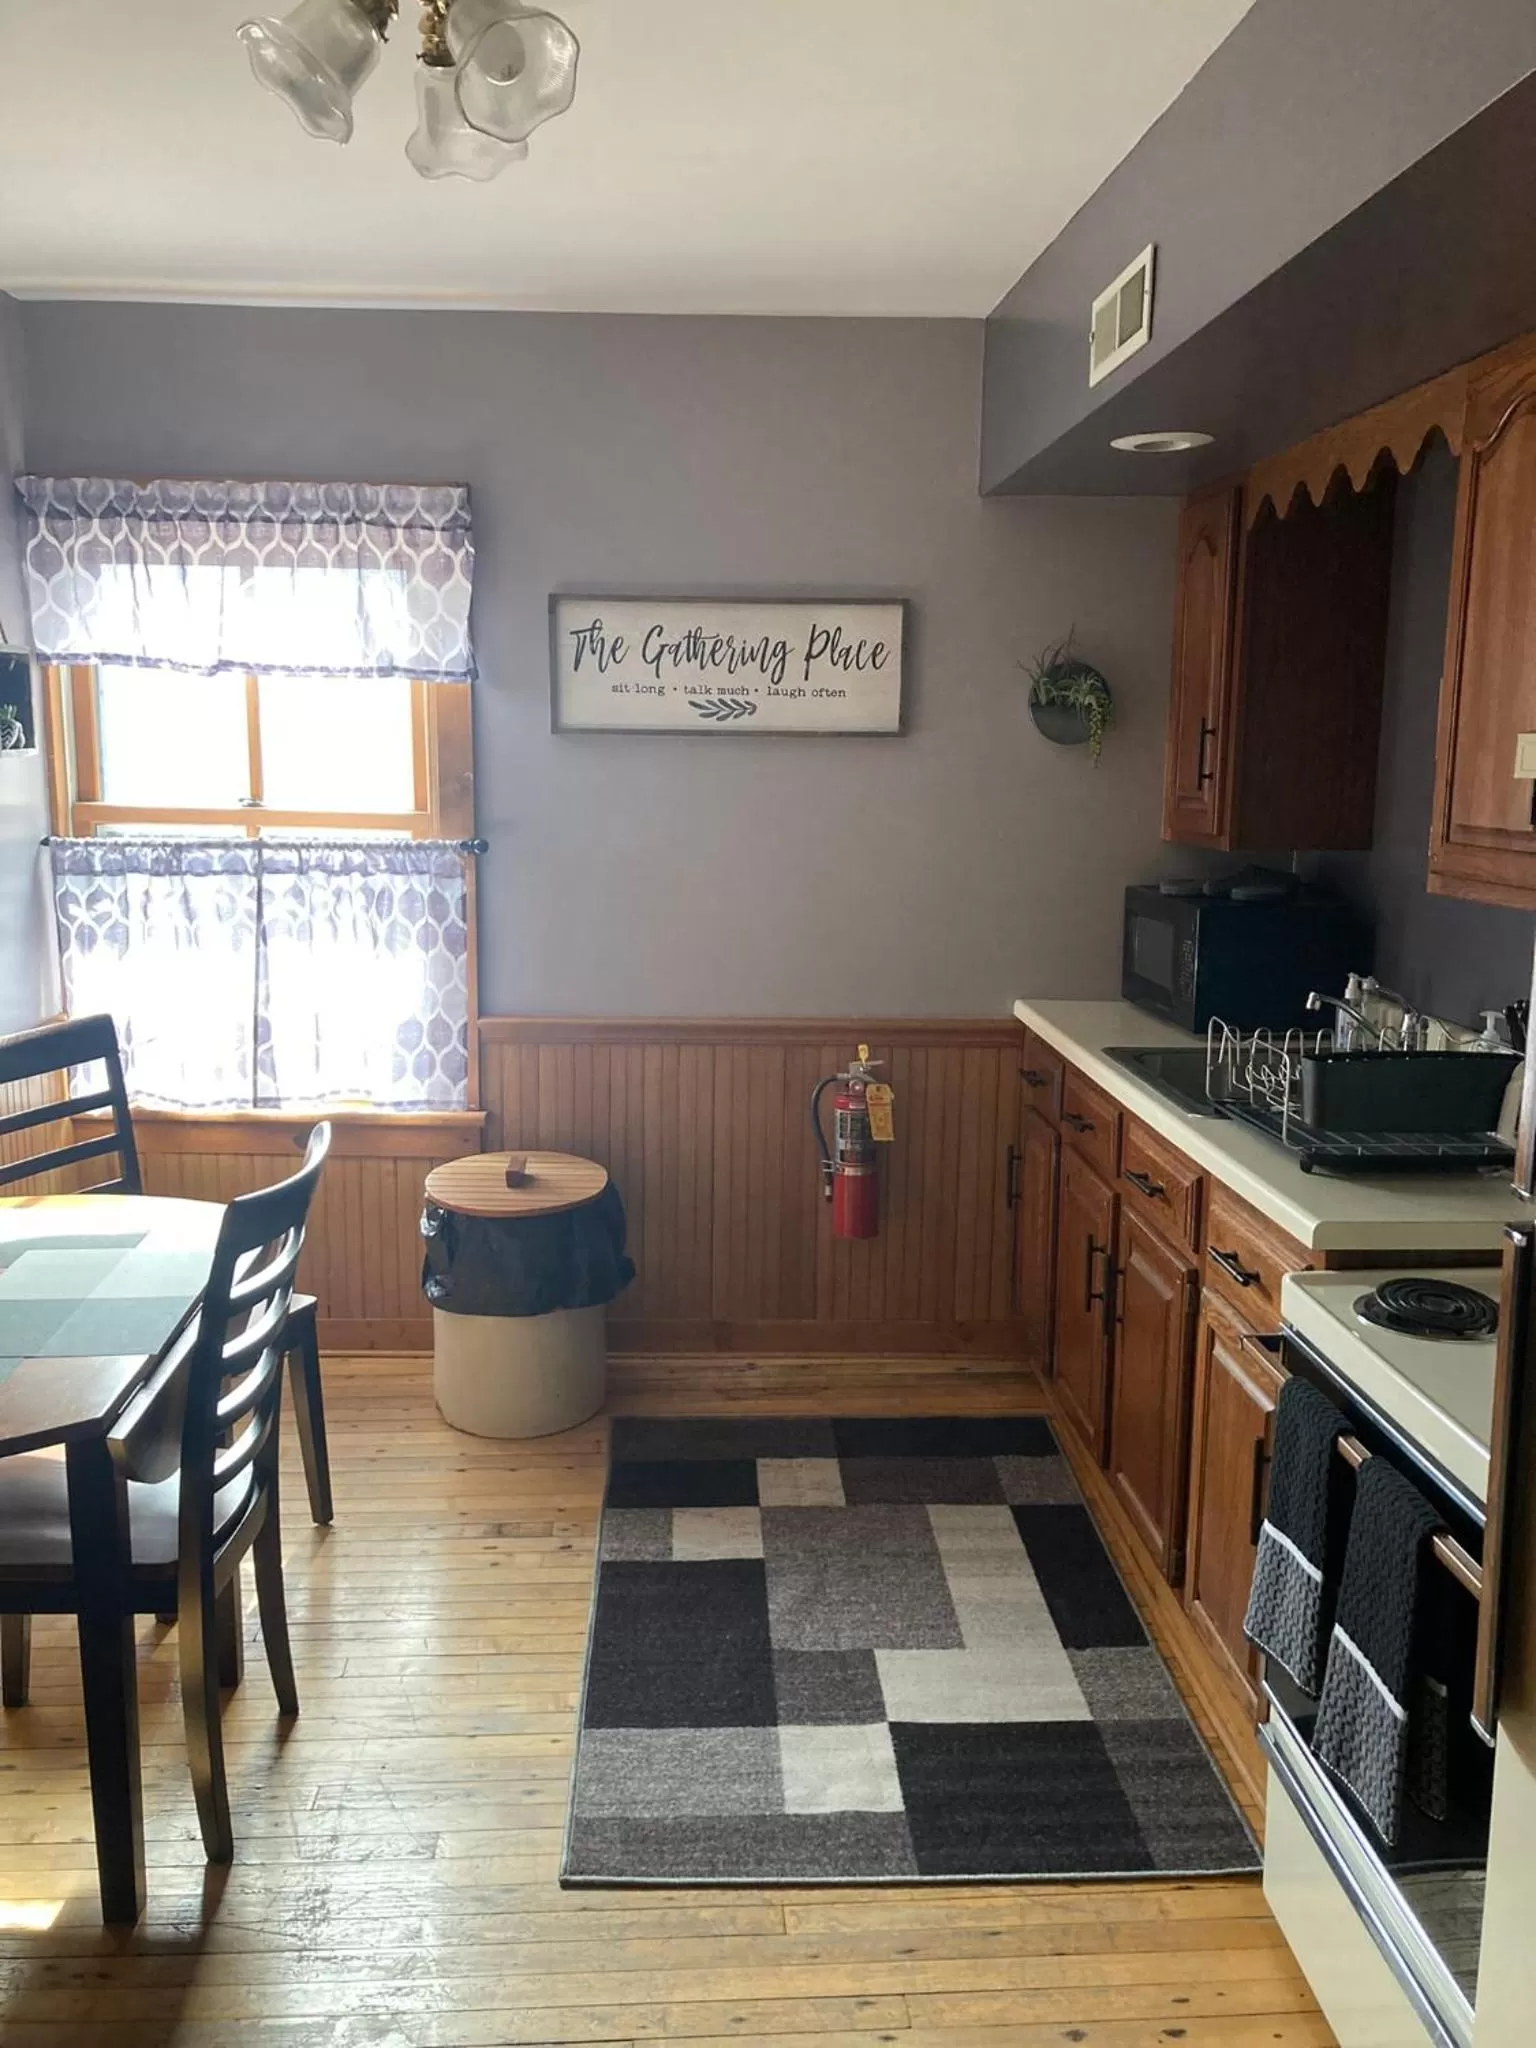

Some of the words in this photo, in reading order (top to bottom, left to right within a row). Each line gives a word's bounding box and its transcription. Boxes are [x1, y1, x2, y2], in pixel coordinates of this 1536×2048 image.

[569, 618, 630, 673] The
[641, 624, 796, 685] Gathering
[804, 623, 891, 682] Place
[611, 683, 630, 693] sit
[635, 683, 666, 696] long
[684, 684, 713, 696] talk
[716, 686, 750, 696] much
[767, 686, 806, 698] laugh
[811, 686, 847, 697] often
